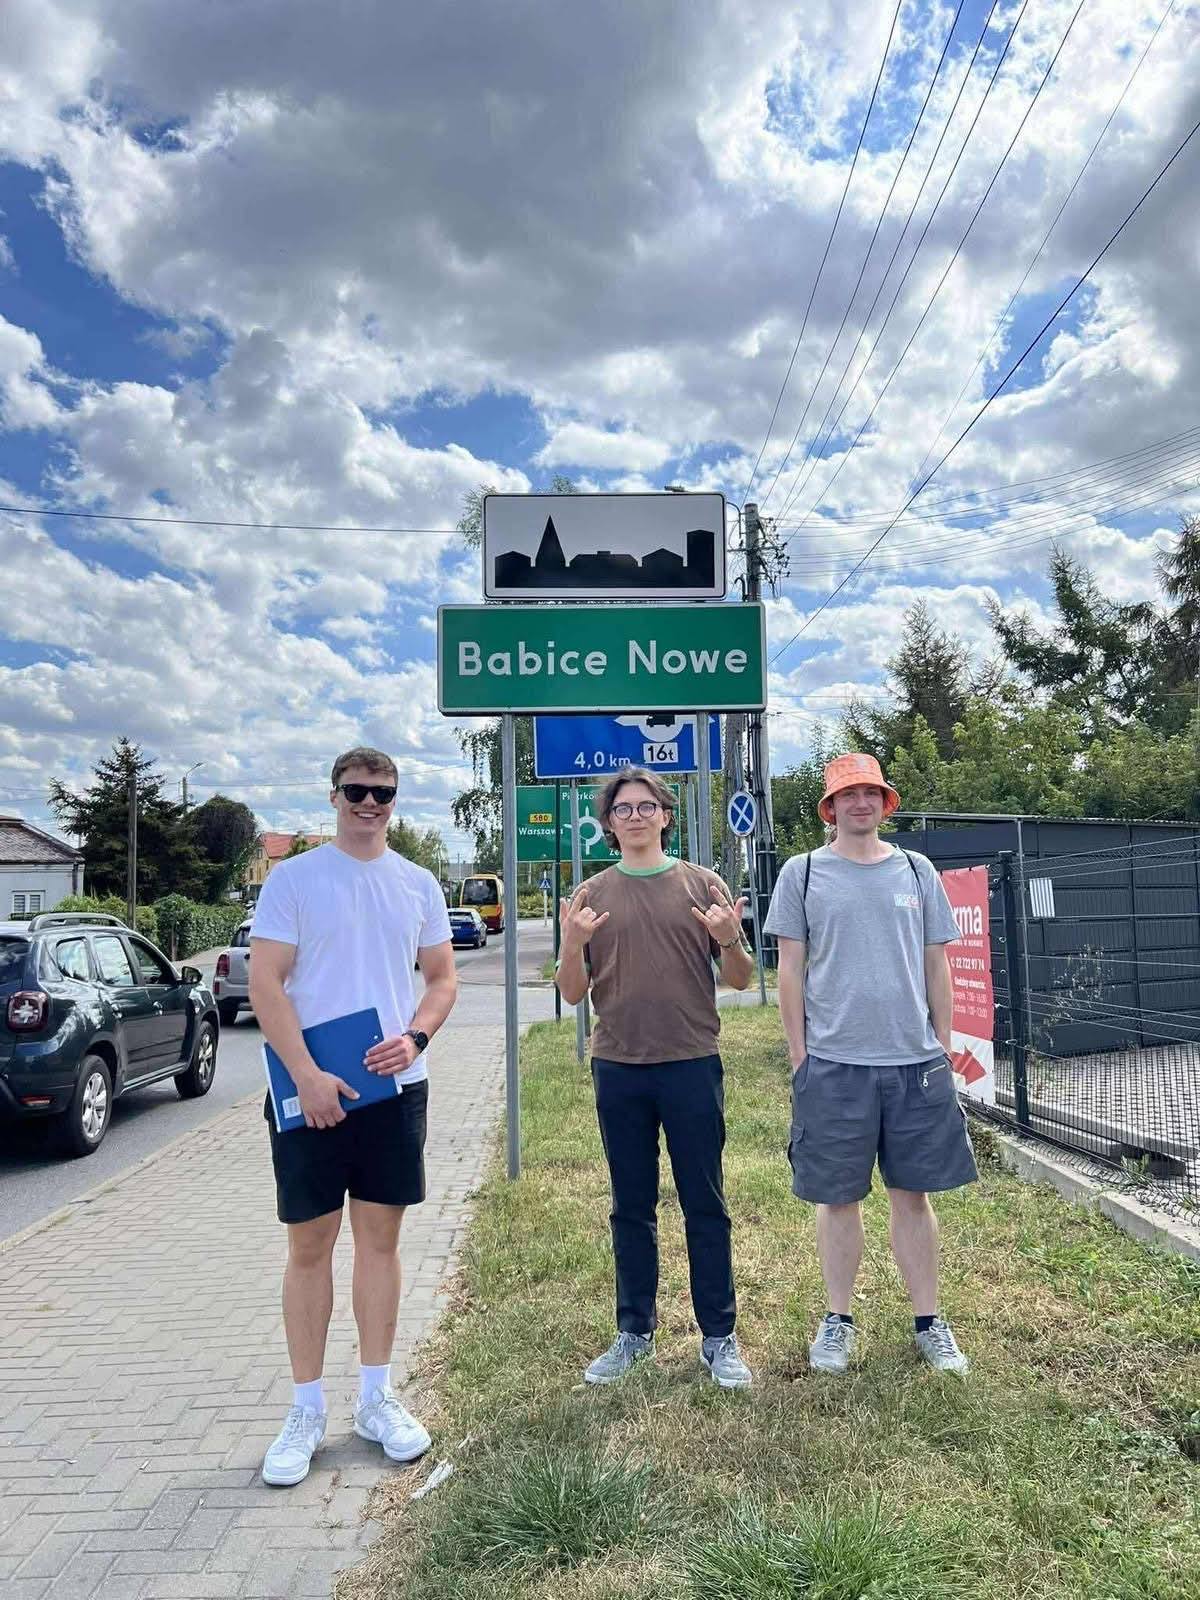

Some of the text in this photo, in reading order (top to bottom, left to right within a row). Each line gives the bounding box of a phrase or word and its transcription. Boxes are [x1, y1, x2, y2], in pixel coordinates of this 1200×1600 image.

[458, 640, 747, 676] Babice Nowe
[574, 751, 631, 770] 4,0 km
[647, 744, 674, 762] 16t
[533, 814, 549, 822] 580
